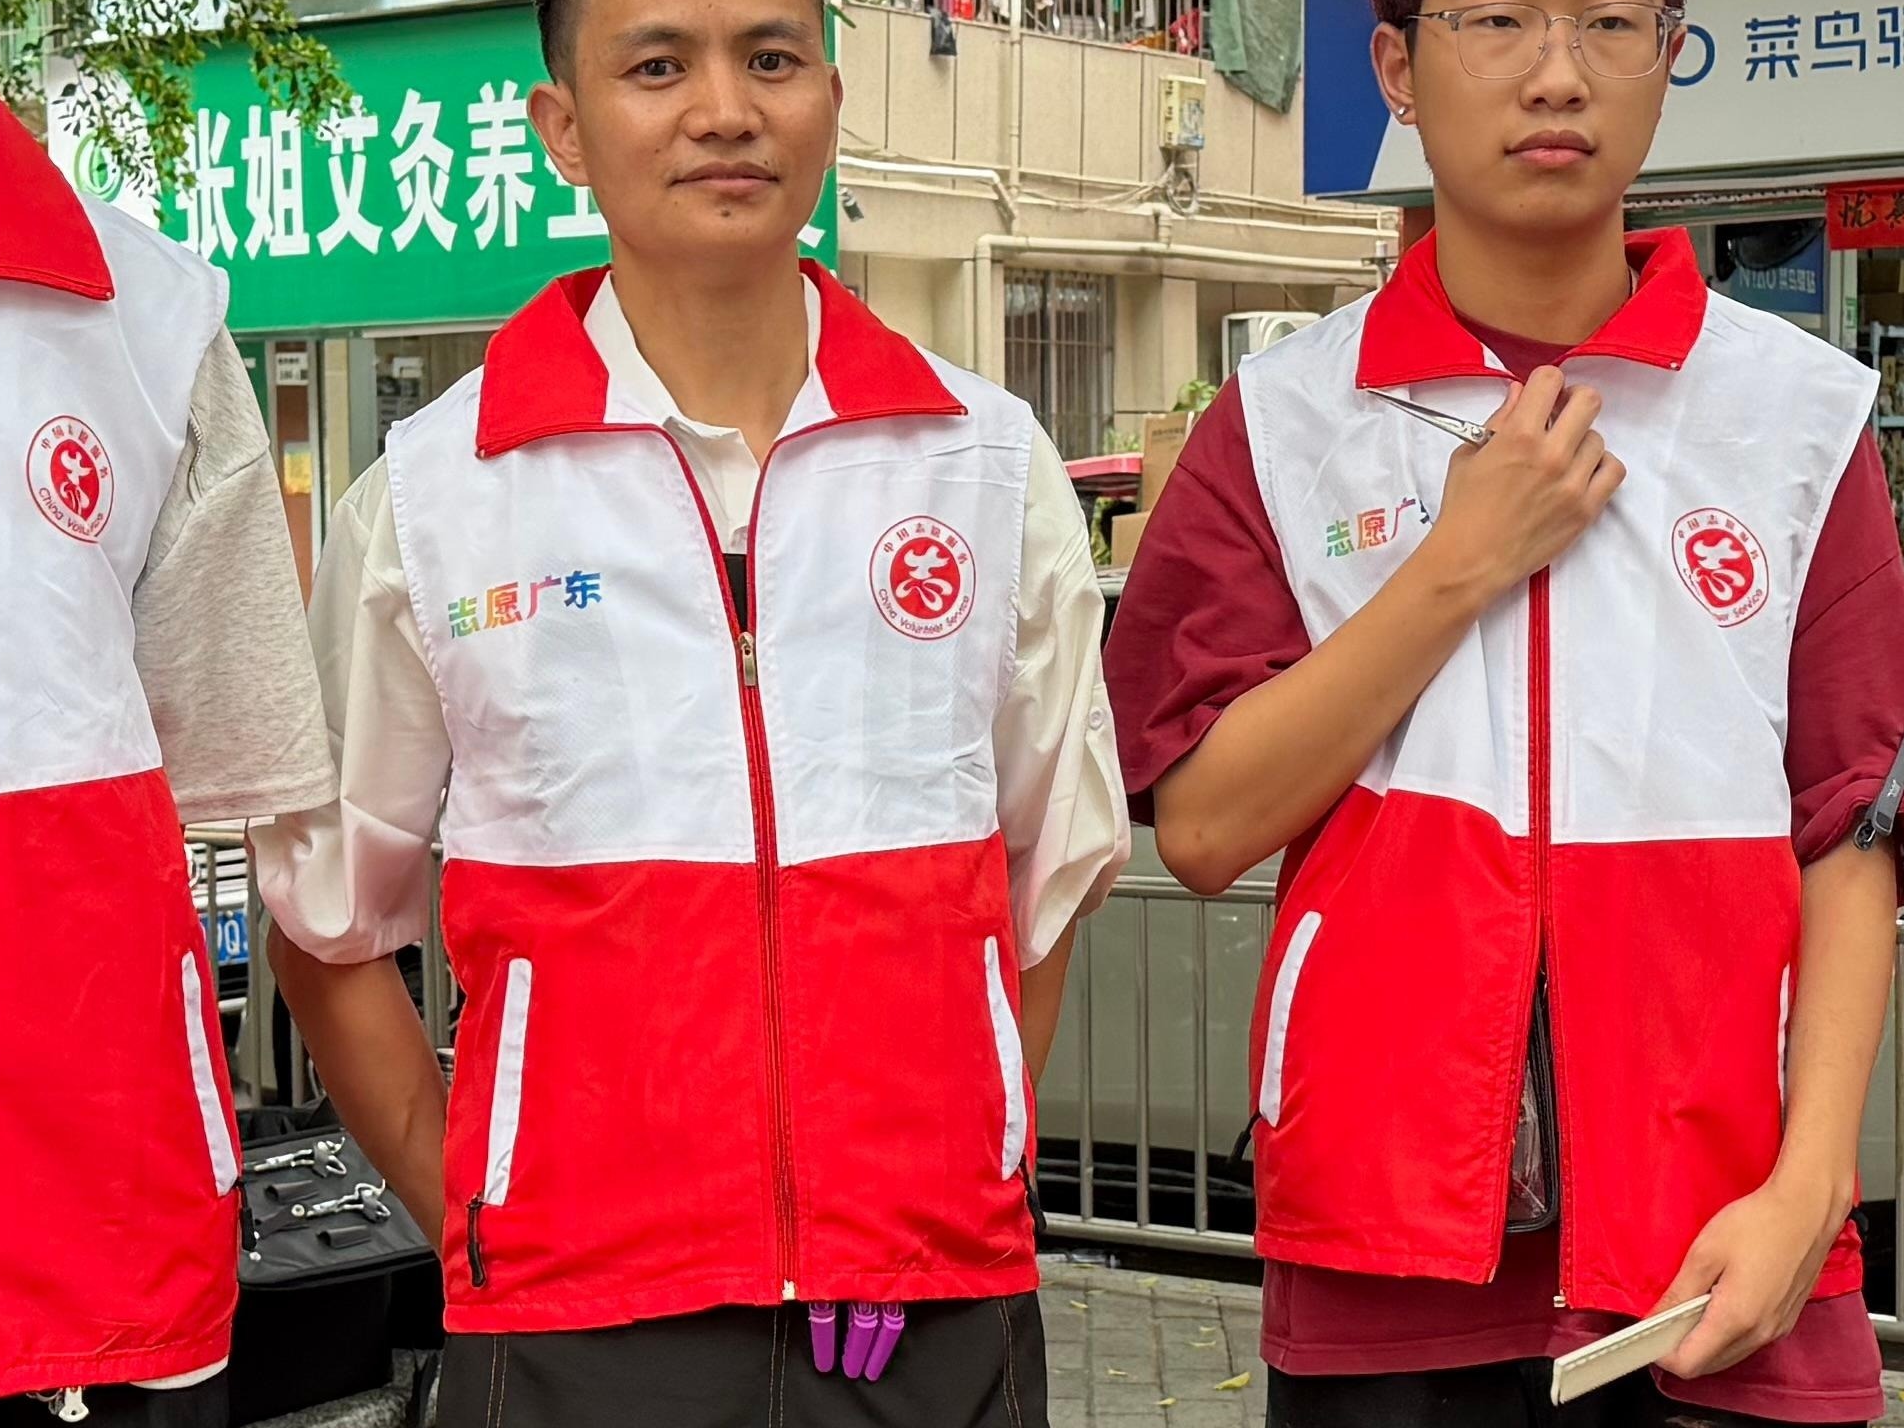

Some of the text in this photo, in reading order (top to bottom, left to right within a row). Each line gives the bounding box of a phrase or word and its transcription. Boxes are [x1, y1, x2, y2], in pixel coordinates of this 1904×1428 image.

[1326, 497, 1433, 557] 志愿广
[447, 570, 603, 639] 志愿广东
